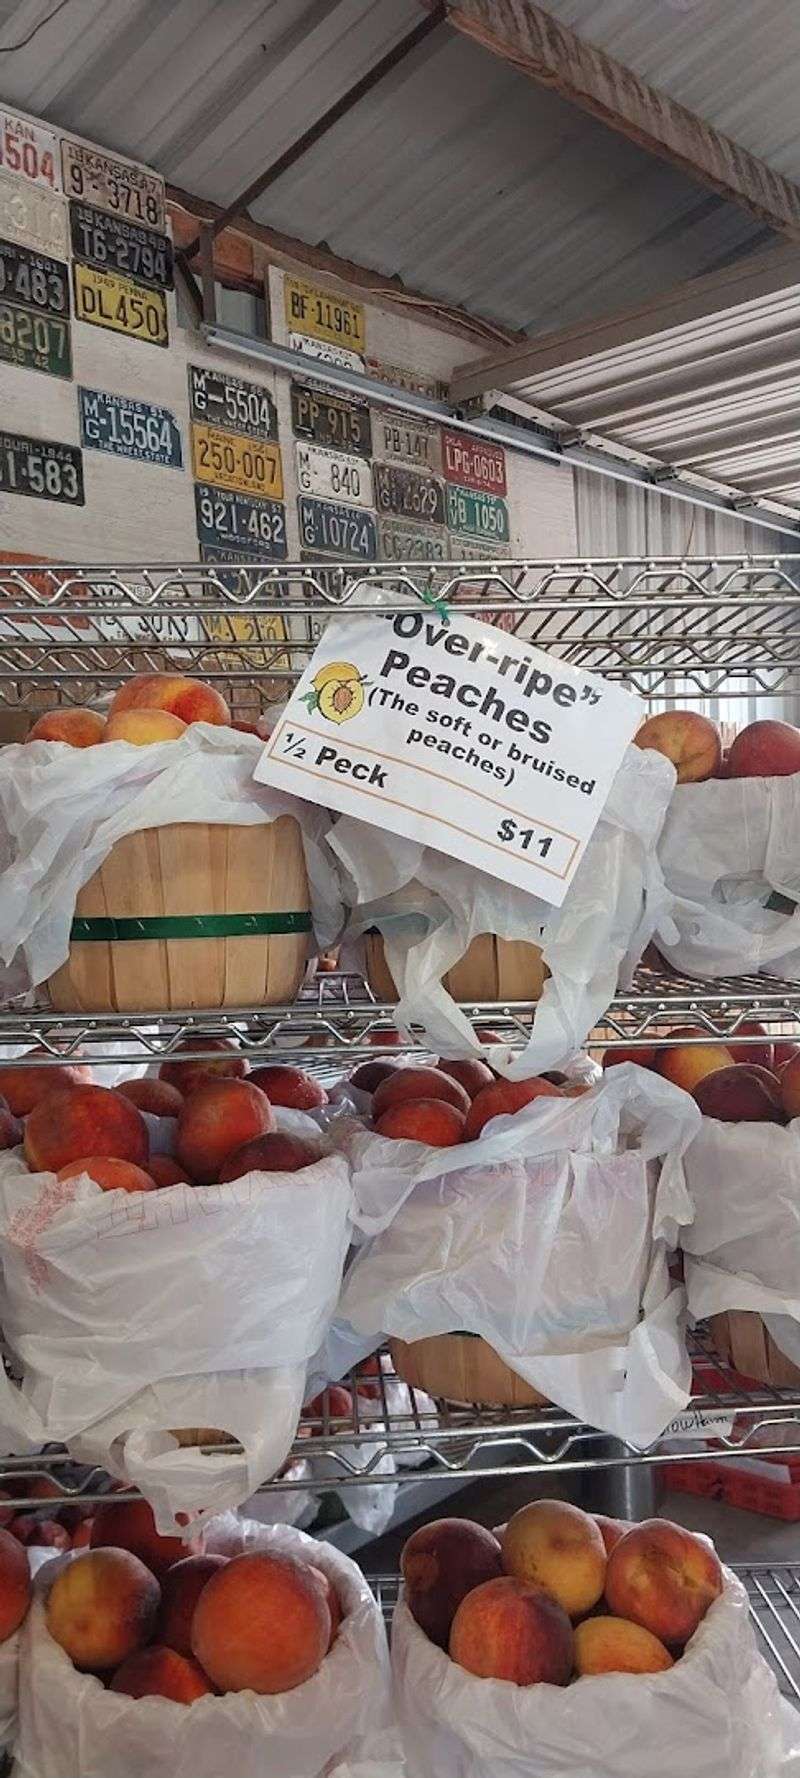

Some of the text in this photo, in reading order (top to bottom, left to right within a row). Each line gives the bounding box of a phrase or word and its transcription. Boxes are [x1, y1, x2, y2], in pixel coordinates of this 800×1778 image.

[79, 223, 167, 283] T6-2794
[82, 285, 159, 337] DL450
[97, 393, 142, 413] KANSAS
[327, 408, 361, 442] 915
[379, 649, 553, 744] Peaches
[367, 686, 597, 796] (The soft or bruised
[406, 727, 517, 787] peaches)
[314, 745, 389, 790] Peck
[497, 818, 554, 858] $11
